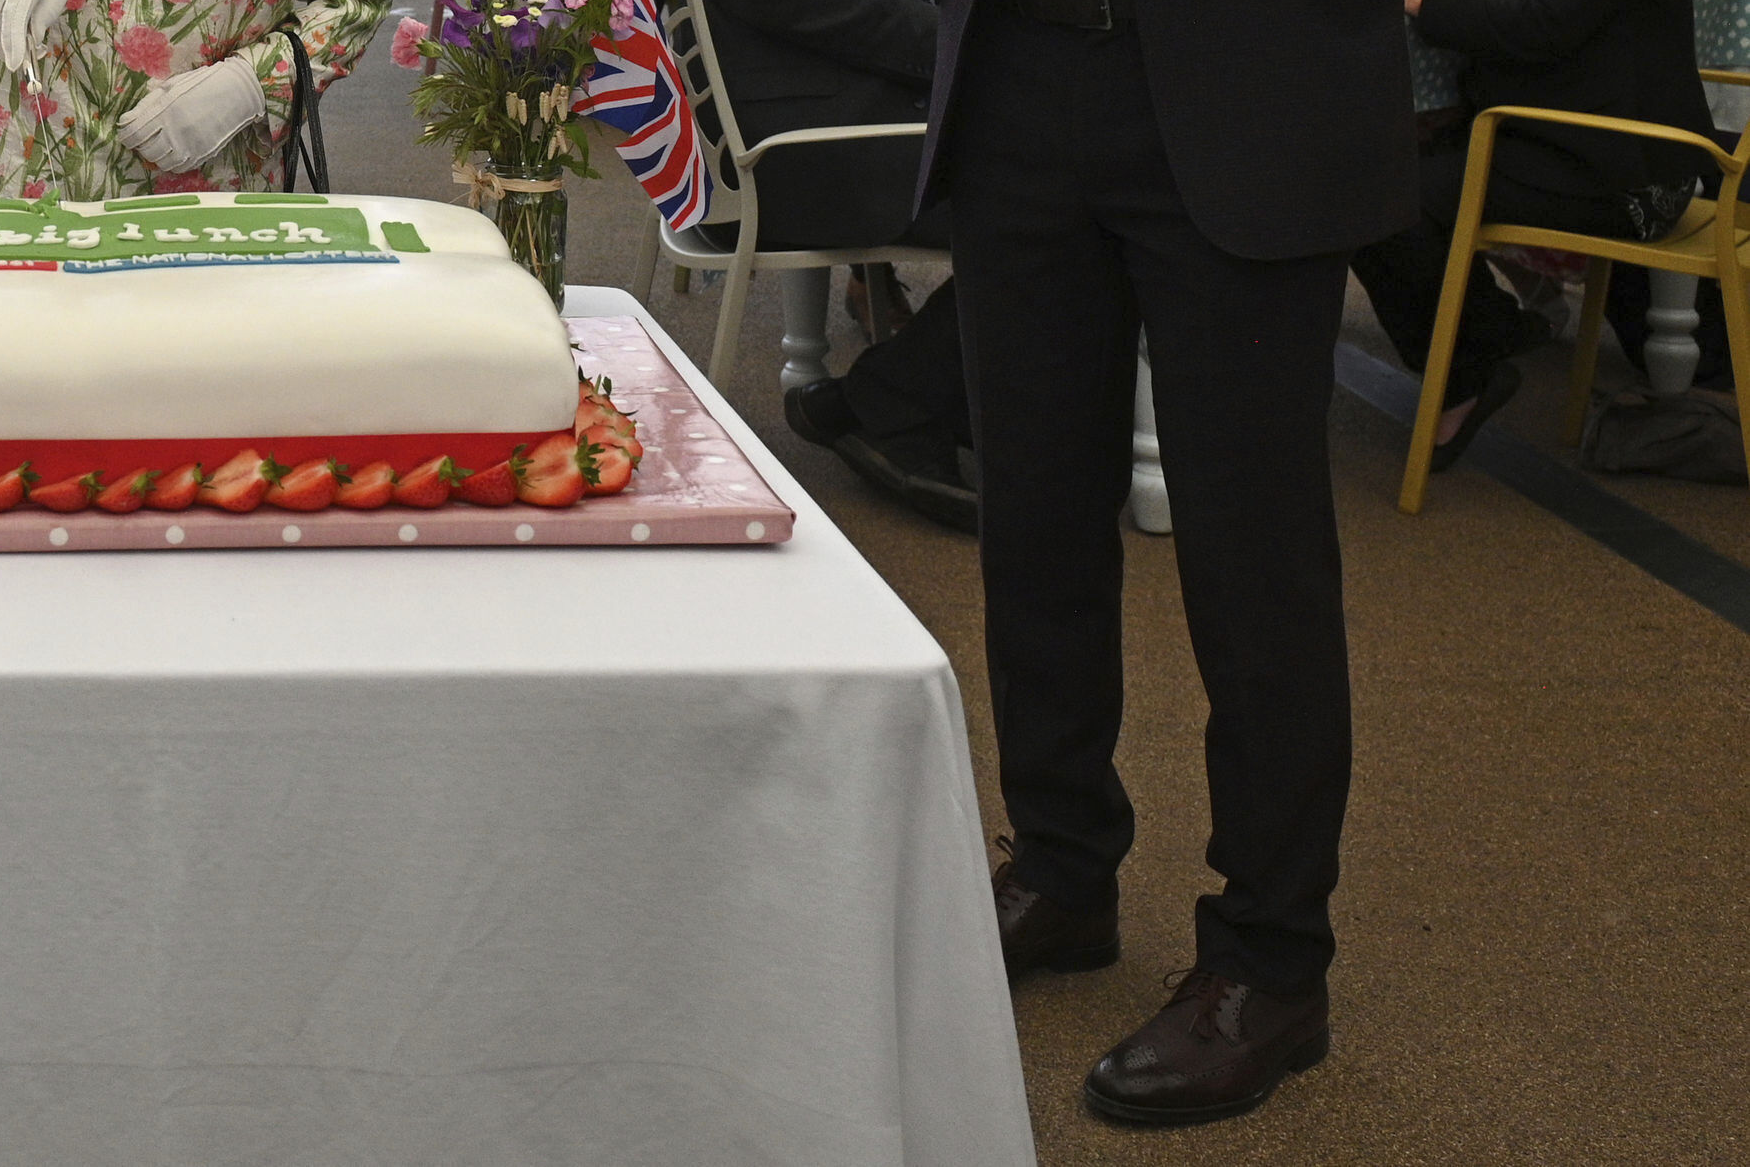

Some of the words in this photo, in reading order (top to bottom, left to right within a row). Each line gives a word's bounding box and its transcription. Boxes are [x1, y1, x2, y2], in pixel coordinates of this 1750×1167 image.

[116, 221, 331, 244] lunch
[66, 258, 123, 268] THE
[132, 252, 263, 264] NATIONAL
